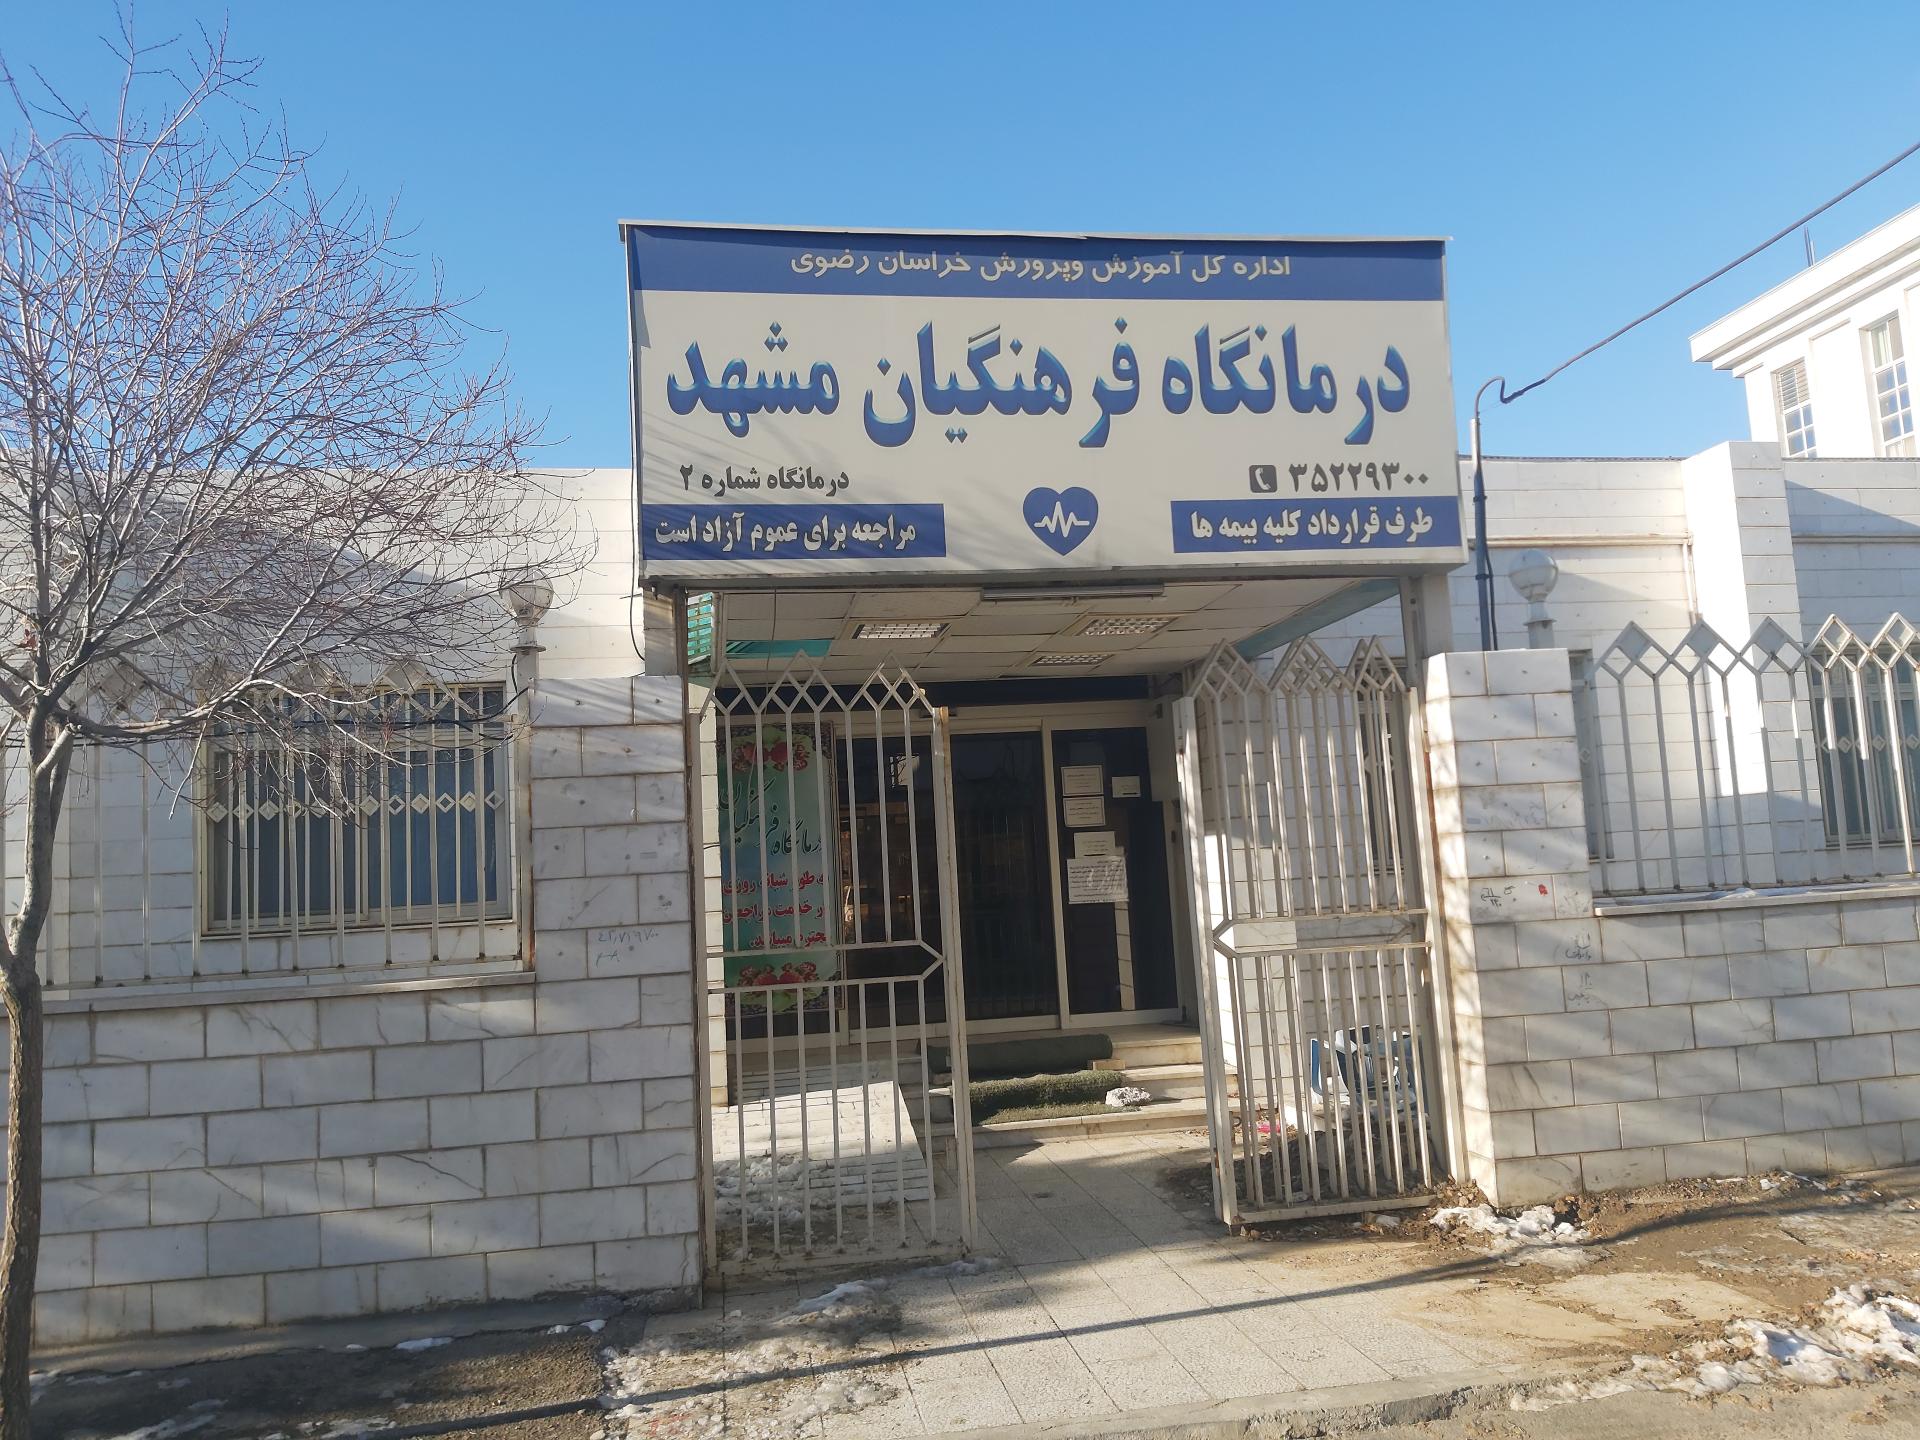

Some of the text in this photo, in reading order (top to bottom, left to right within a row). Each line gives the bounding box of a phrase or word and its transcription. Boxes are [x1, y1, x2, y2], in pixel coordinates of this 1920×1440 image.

[790, 248, 871, 279] رضوی
[878, 249, 972, 279] خراسان
[1092, 250, 1183, 284] آموزش
[1191, 254, 1226, 284] کل
[1233, 255, 1291, 281] اداره
[666, 315, 1411, 449] درمانگاه فرهنگیان مشهد
[679, 463, 850, 498] درمانگاه شماره ۲
[1288, 461, 1430, 493] ۳۵۲۲۹۳۰۰
[655, 512, 917, 553] مراجعه برای عموم آزاد است
[1191, 505, 1433, 546] طرف قرارداد کلیه بیمه ها
[771, 818, 824, 856] رماگاه
